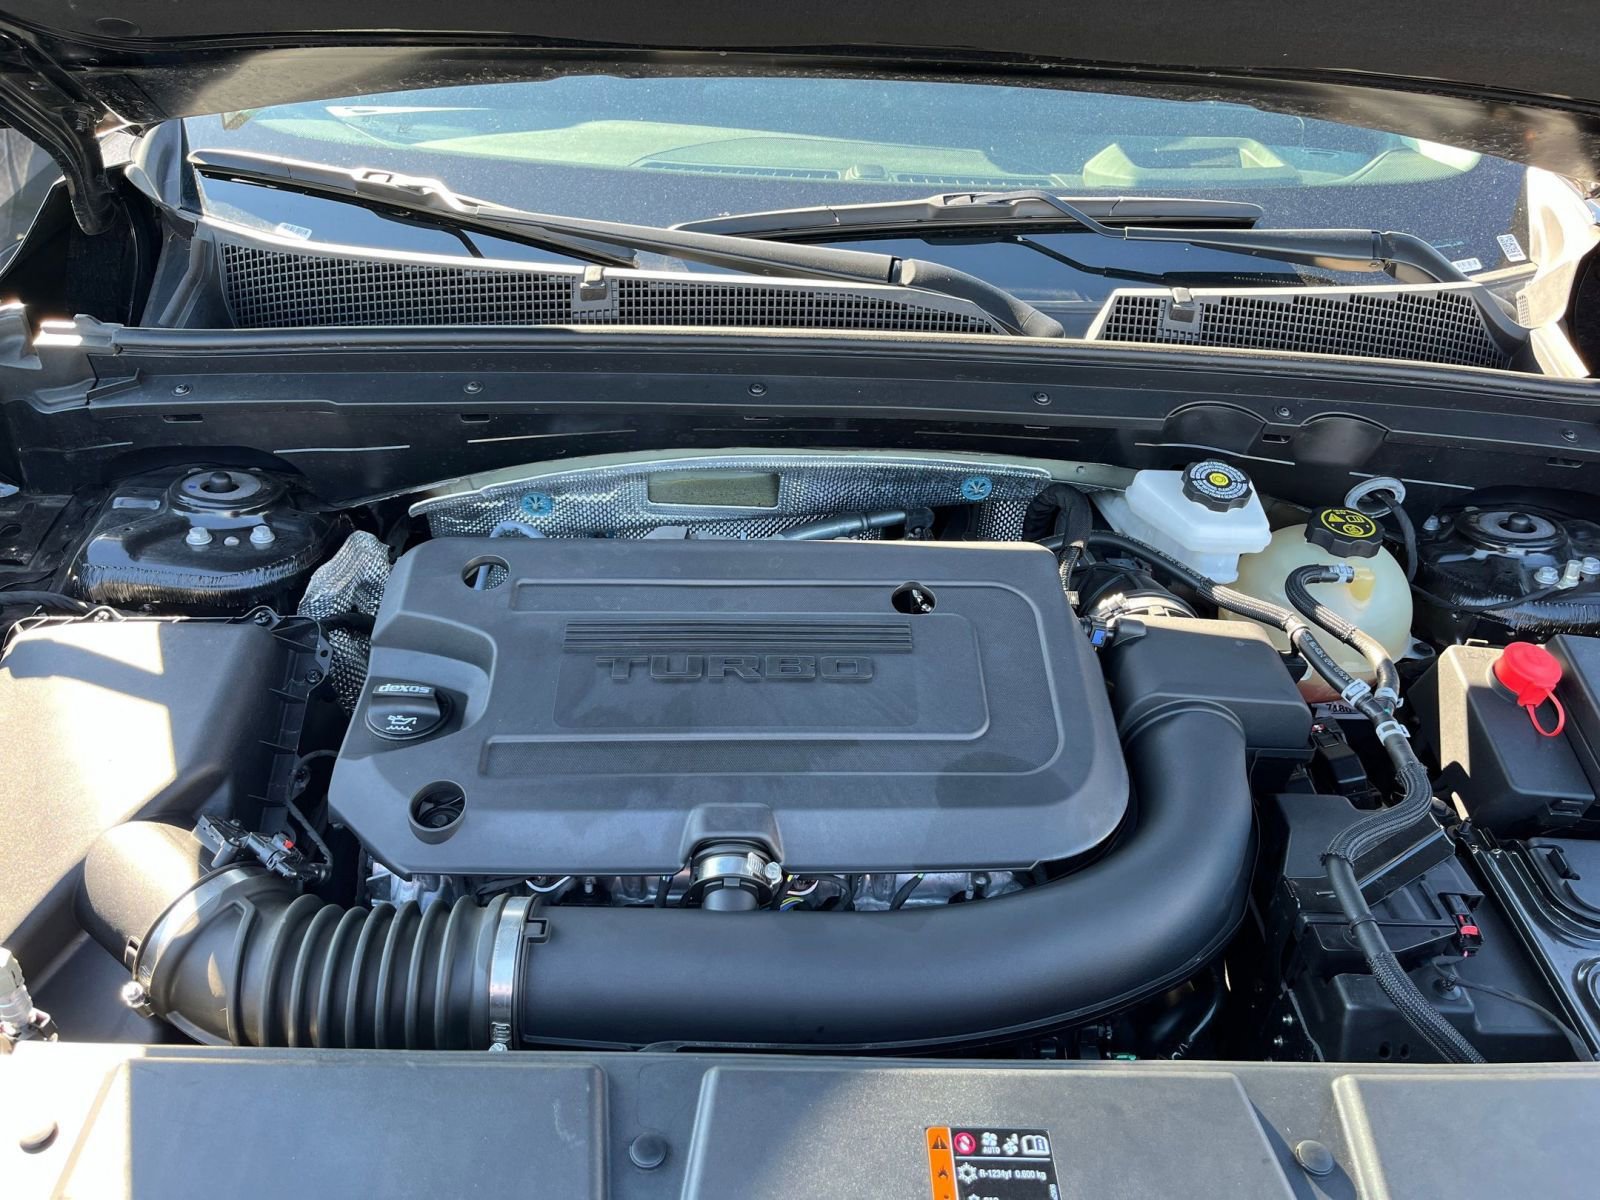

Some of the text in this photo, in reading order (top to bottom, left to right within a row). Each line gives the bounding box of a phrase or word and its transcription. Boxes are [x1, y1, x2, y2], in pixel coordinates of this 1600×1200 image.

[596, 655, 873, 680] TURBO
[378, 683, 432, 694] dexos
[982, 1146, 1001, 1155] AUTO
